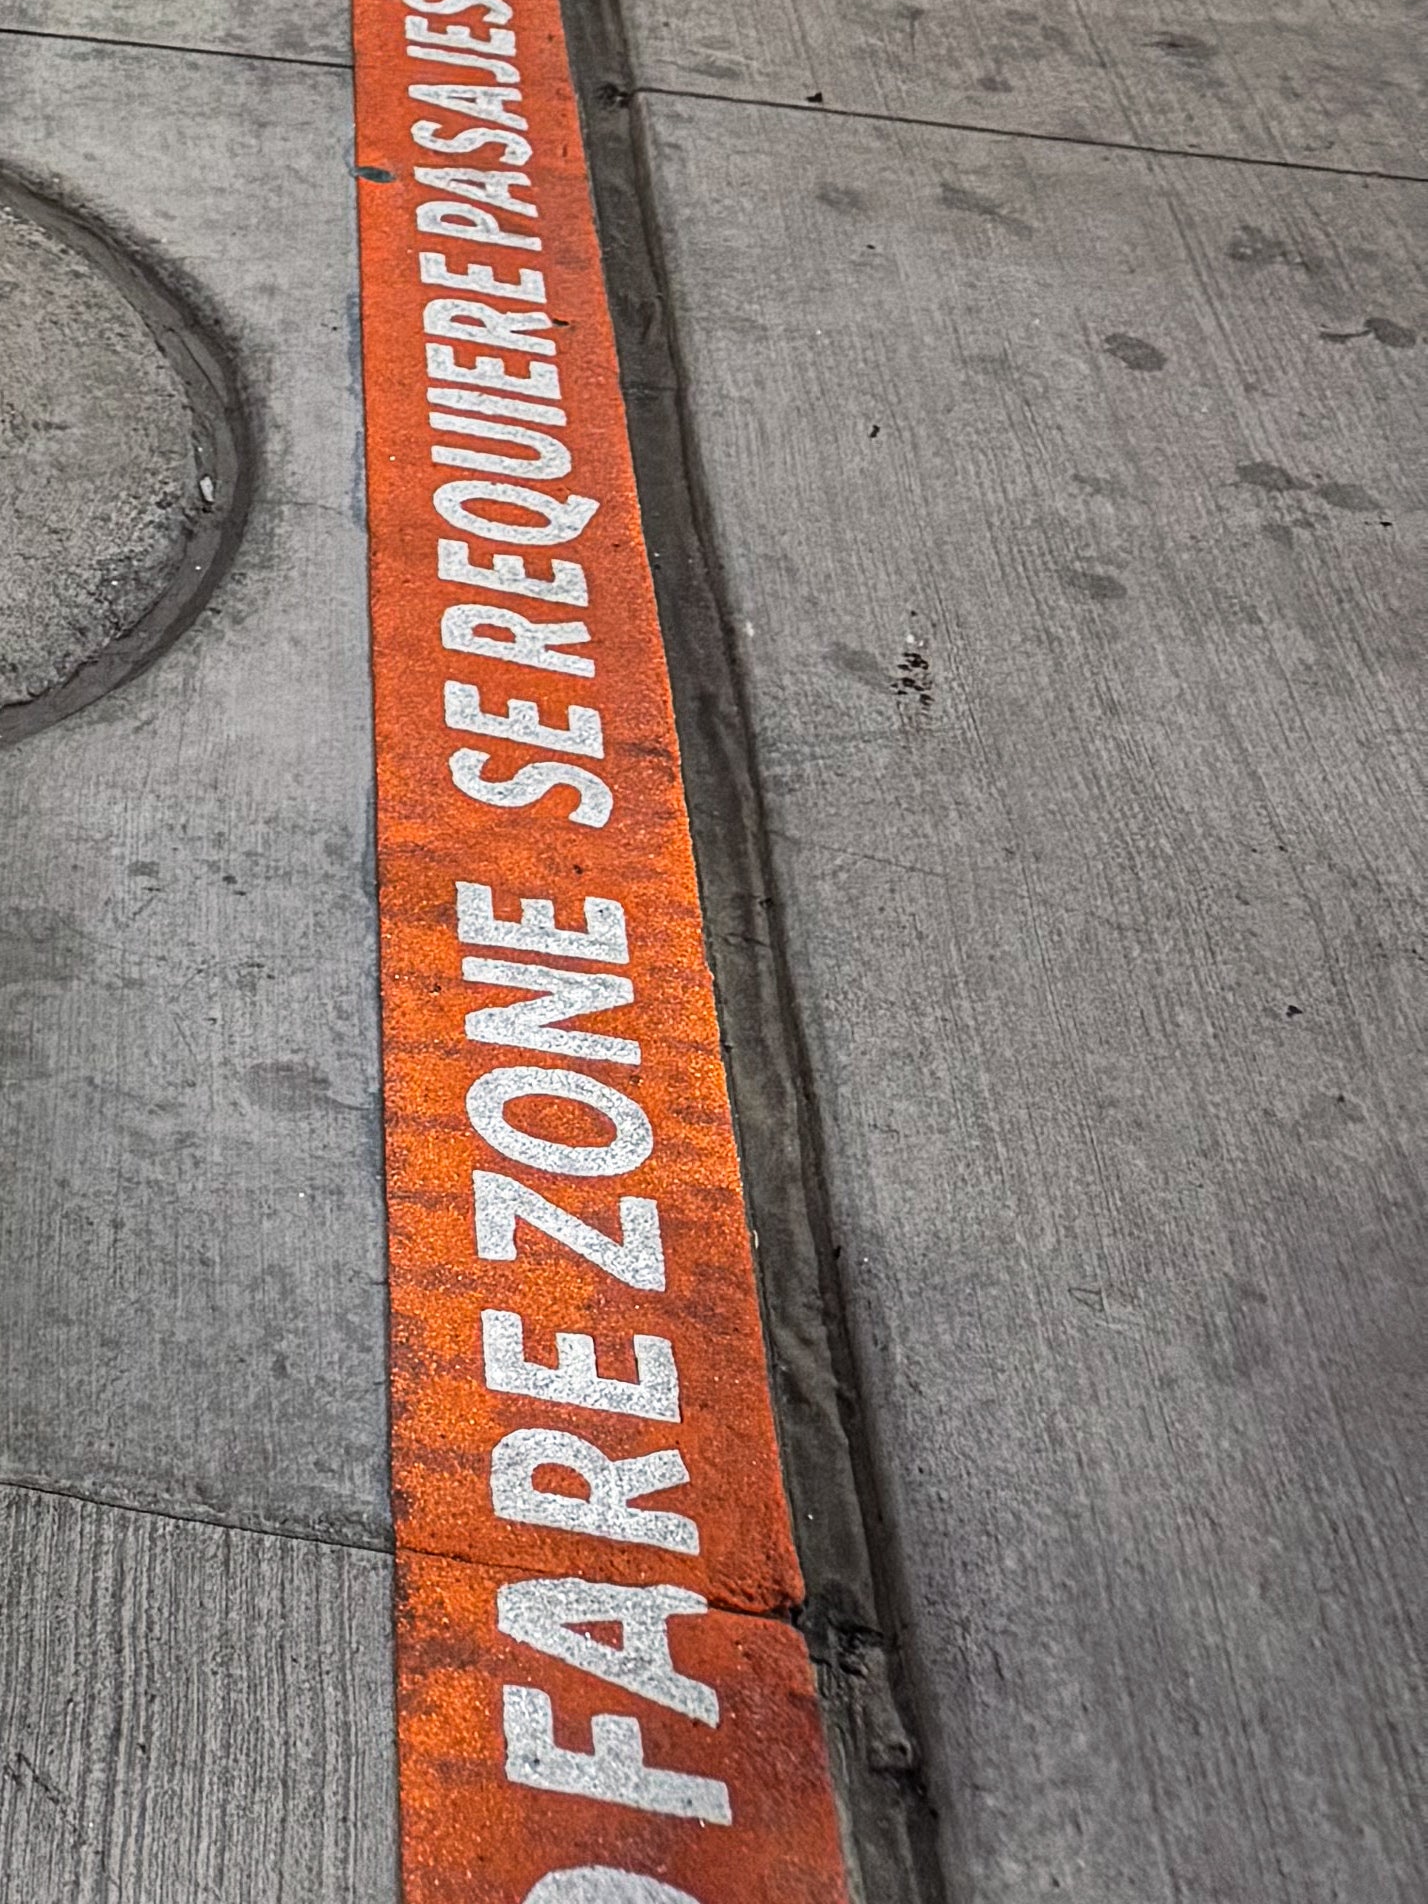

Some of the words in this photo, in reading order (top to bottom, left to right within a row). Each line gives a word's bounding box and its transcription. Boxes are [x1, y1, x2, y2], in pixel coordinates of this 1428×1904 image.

[419, 252, 599, 678] REQUIERE
[445, 681, 614, 828] SE
[455, 881, 666, 1291] ZONE
[480, 1309, 732, 1826] FARE
